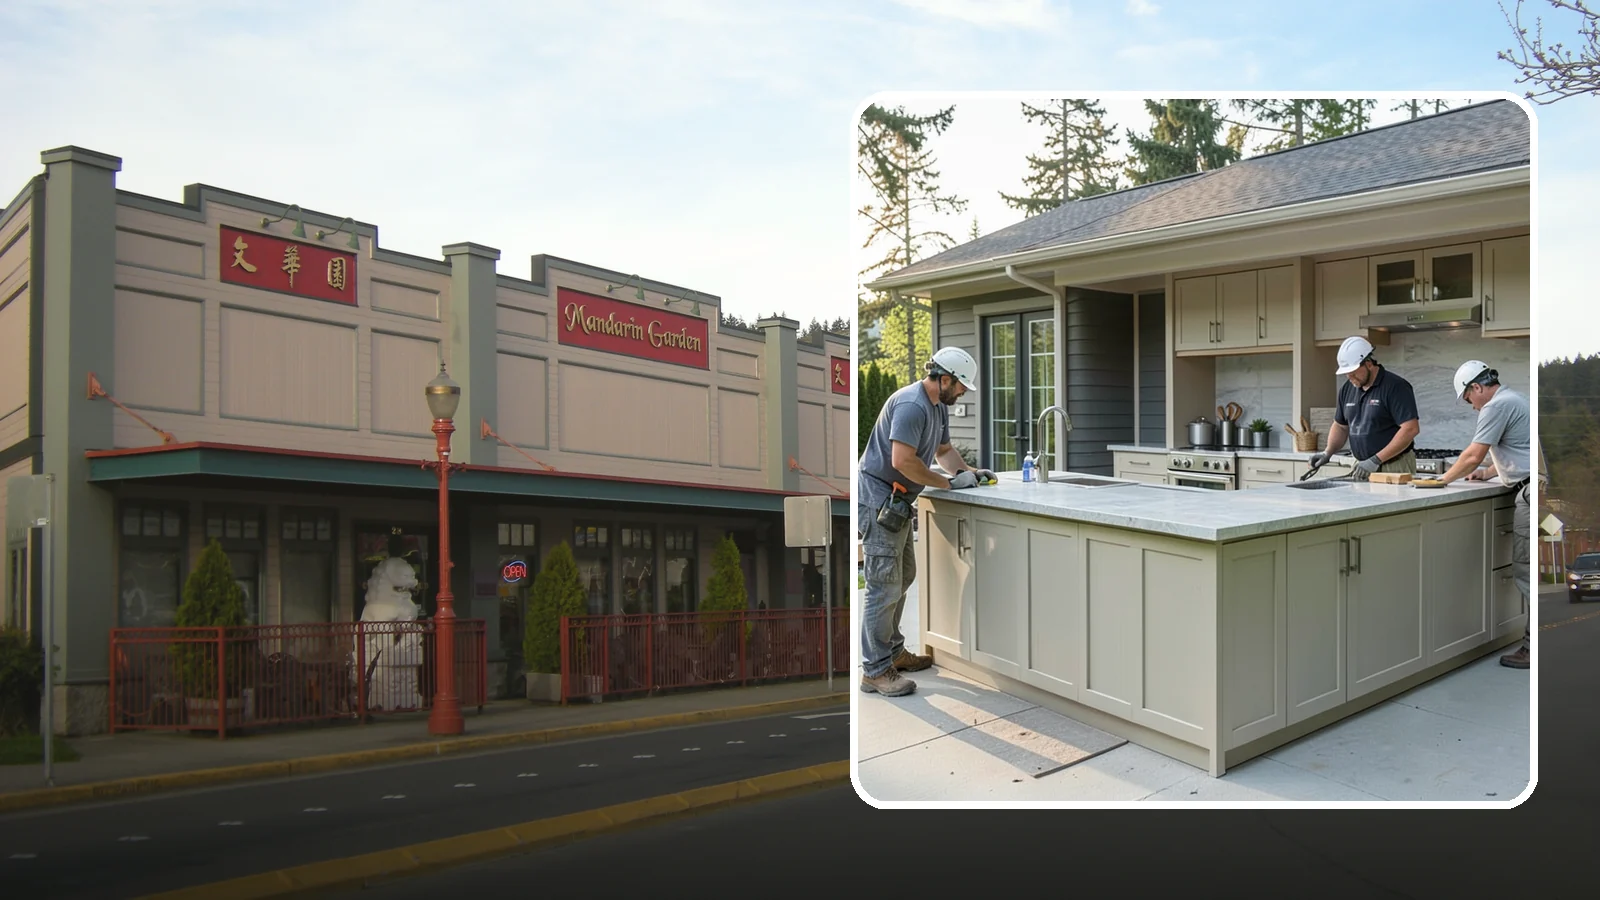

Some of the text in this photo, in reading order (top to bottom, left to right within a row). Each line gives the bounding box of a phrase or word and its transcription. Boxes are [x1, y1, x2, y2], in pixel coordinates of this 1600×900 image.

[230, 235, 346, 291] 文華園
[564, 302, 702, 352] Mandarin Garden
[503, 565, 527, 578] OPEN
